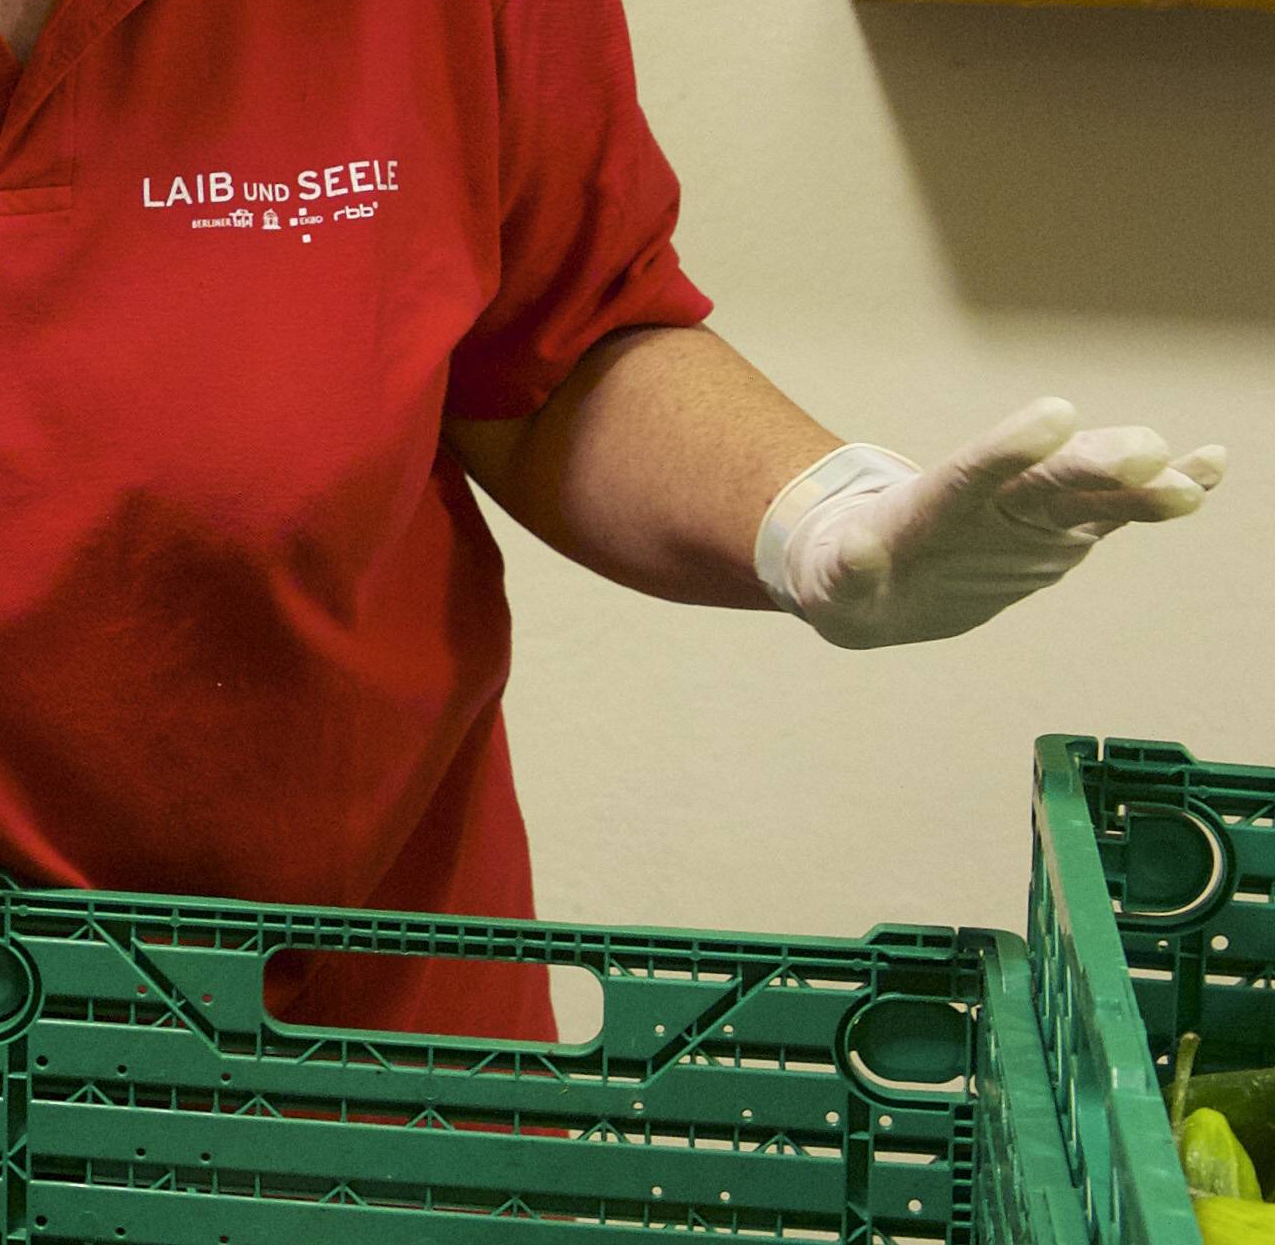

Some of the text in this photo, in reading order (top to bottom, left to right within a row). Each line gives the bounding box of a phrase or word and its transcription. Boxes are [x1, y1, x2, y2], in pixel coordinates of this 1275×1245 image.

[142, 159, 399, 208] LAIB UND SEELE
[333, 202, 375, 221] rbb
